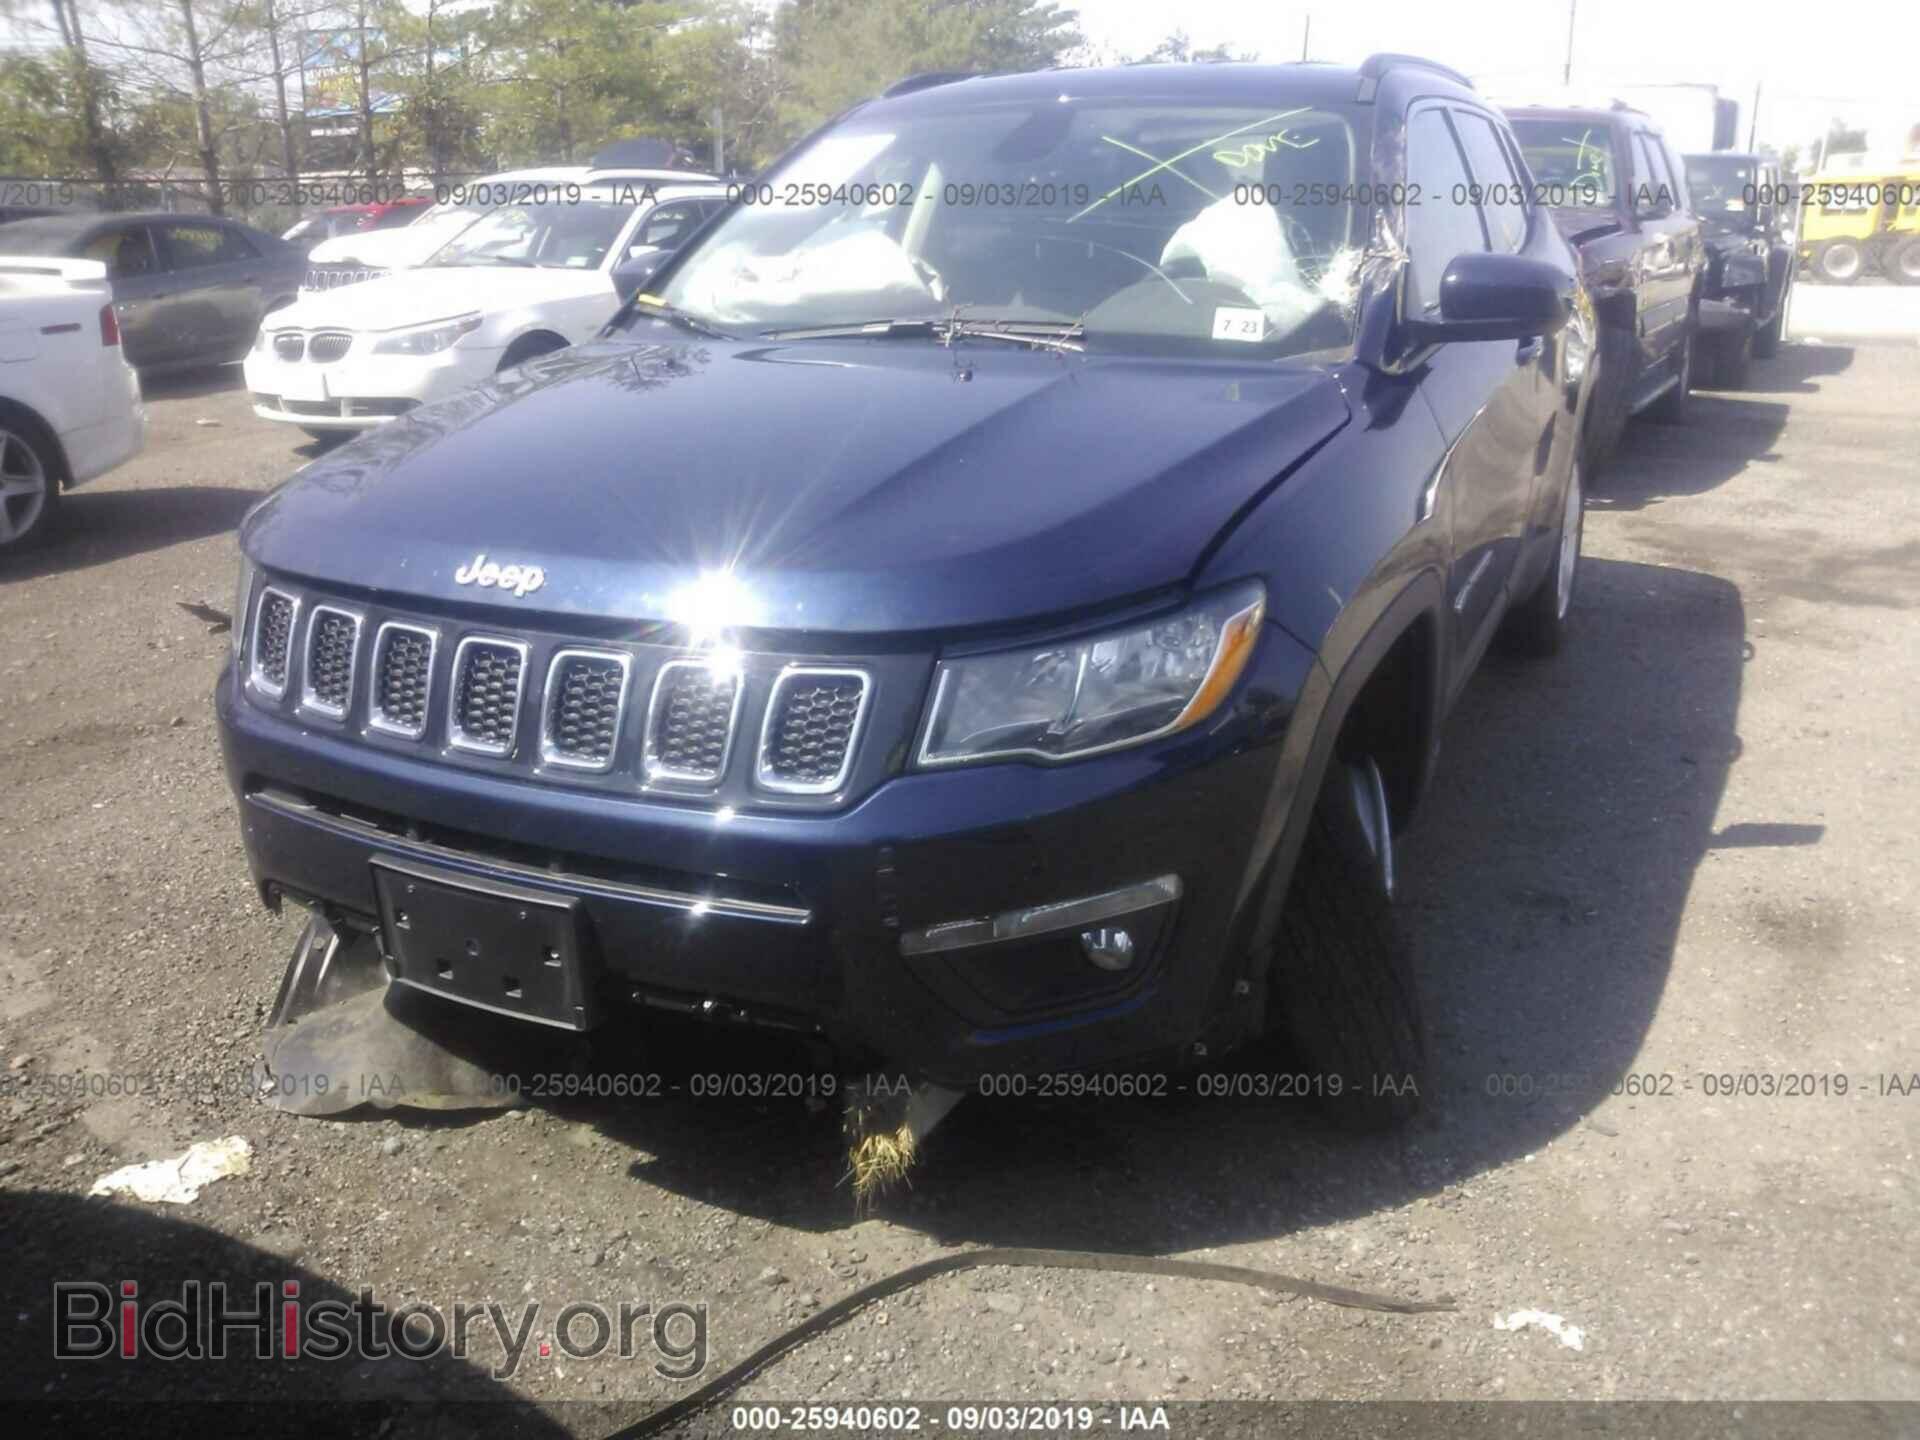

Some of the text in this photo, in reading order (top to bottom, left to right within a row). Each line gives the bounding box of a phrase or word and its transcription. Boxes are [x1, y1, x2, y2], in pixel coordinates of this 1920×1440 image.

[1223, 319, 1257, 333] 7 23
[455, 554, 545, 598] Jeep
